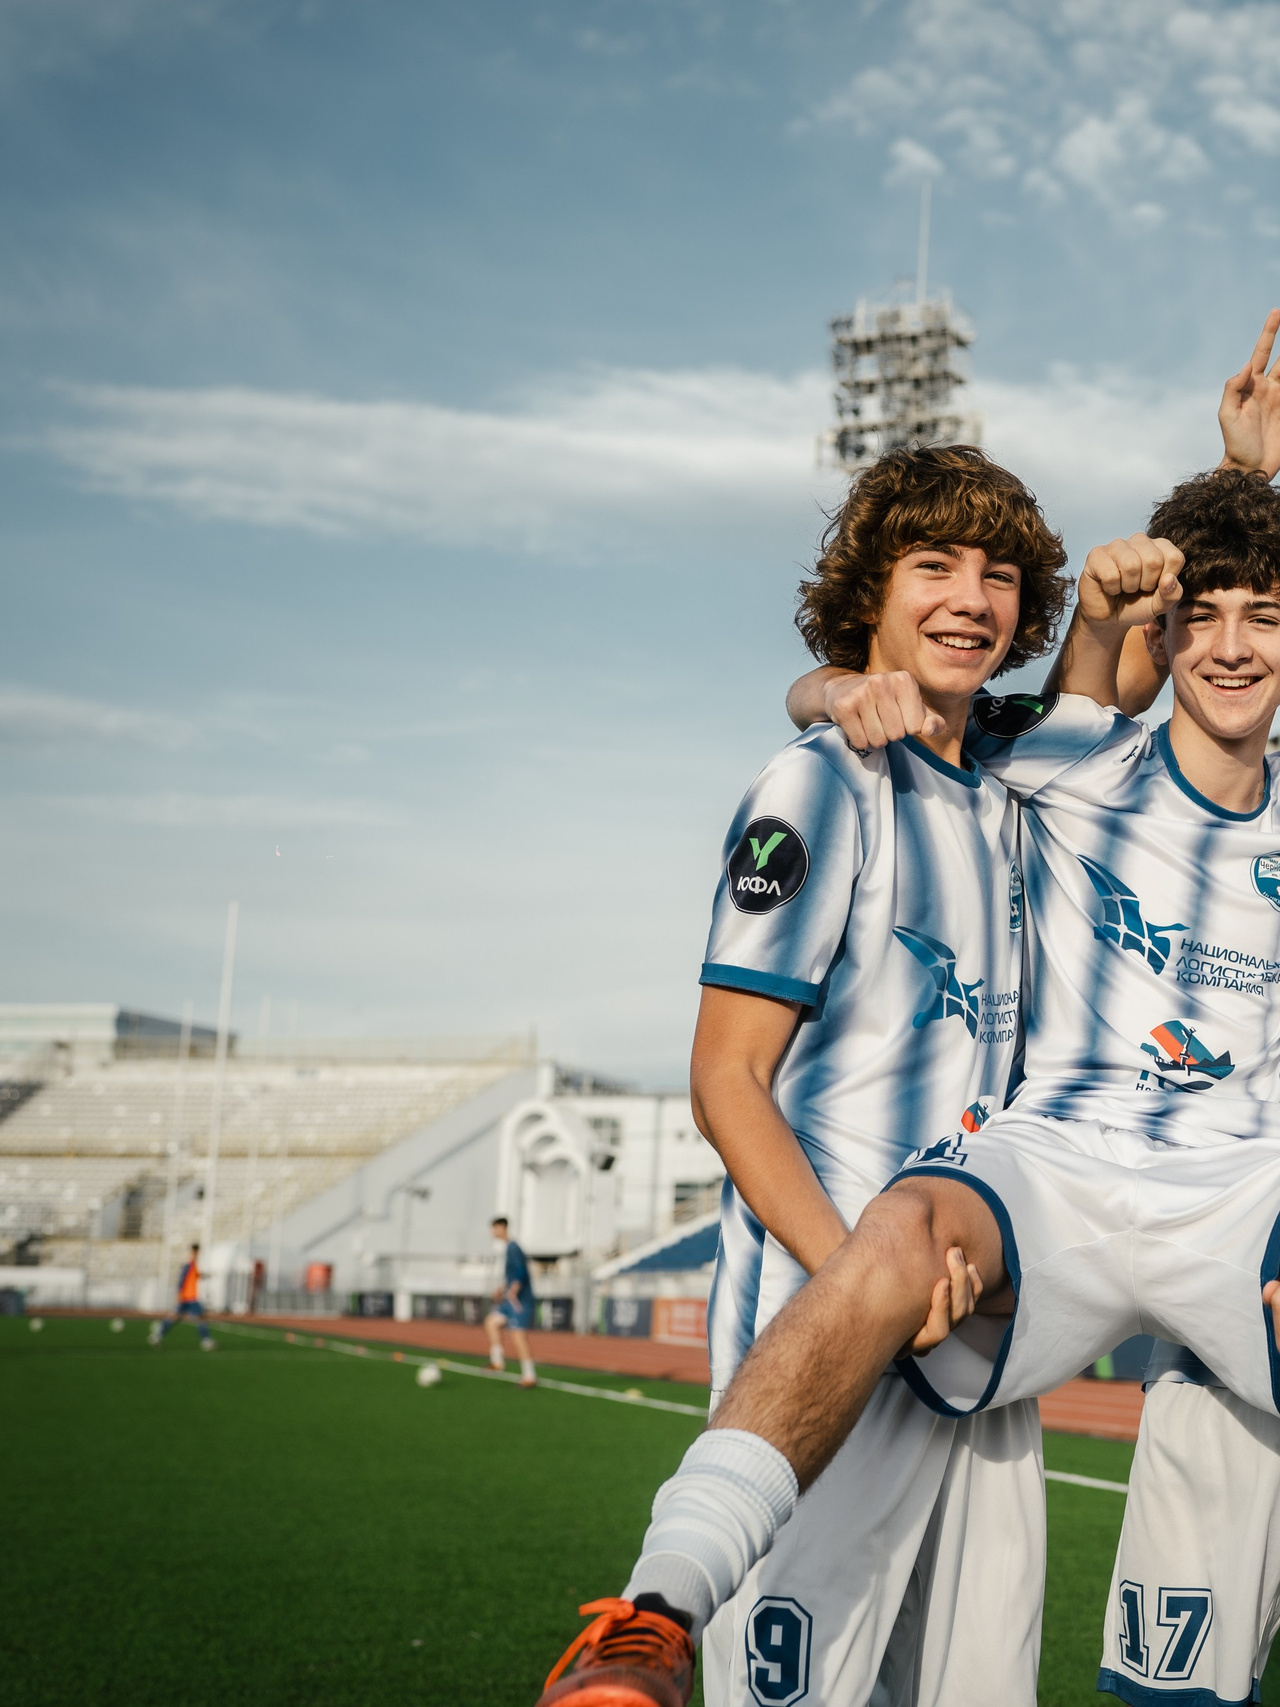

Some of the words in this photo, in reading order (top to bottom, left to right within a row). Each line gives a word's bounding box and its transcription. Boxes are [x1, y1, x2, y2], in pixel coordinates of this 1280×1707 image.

[737, 876, 781, 896] ЮФЛ
[1176, 970, 1264, 997] КОМПАНИЯ
[981, 989, 1020, 1007] НАЦИОНА
[979, 1029, 1015, 1044] КОМПА
[1119, 1579, 1213, 1681] 17
[745, 1595, 813, 1707] 9
